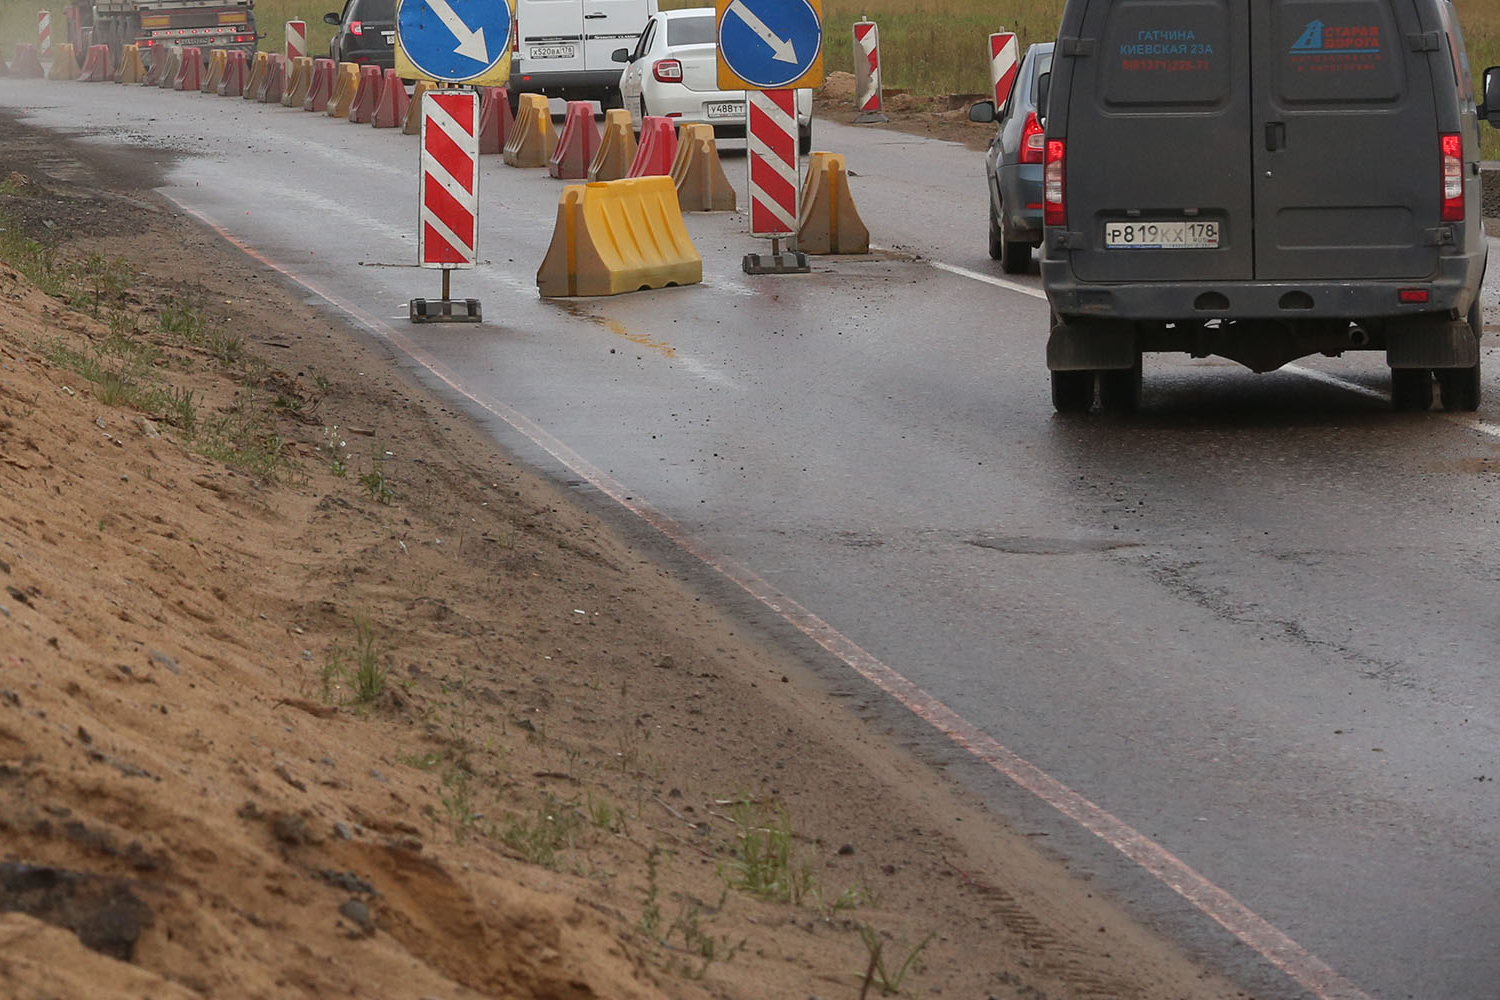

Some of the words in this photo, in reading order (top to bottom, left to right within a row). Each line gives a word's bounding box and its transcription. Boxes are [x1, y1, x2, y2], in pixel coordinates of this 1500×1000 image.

[1138, 30, 1196, 41] ГАТЧИНА
[1120, 44, 1188, 55] КИЕВСКАЯ
[1190, 44, 1213, 55] 23А
[1189, 224, 1215, 238] 178
